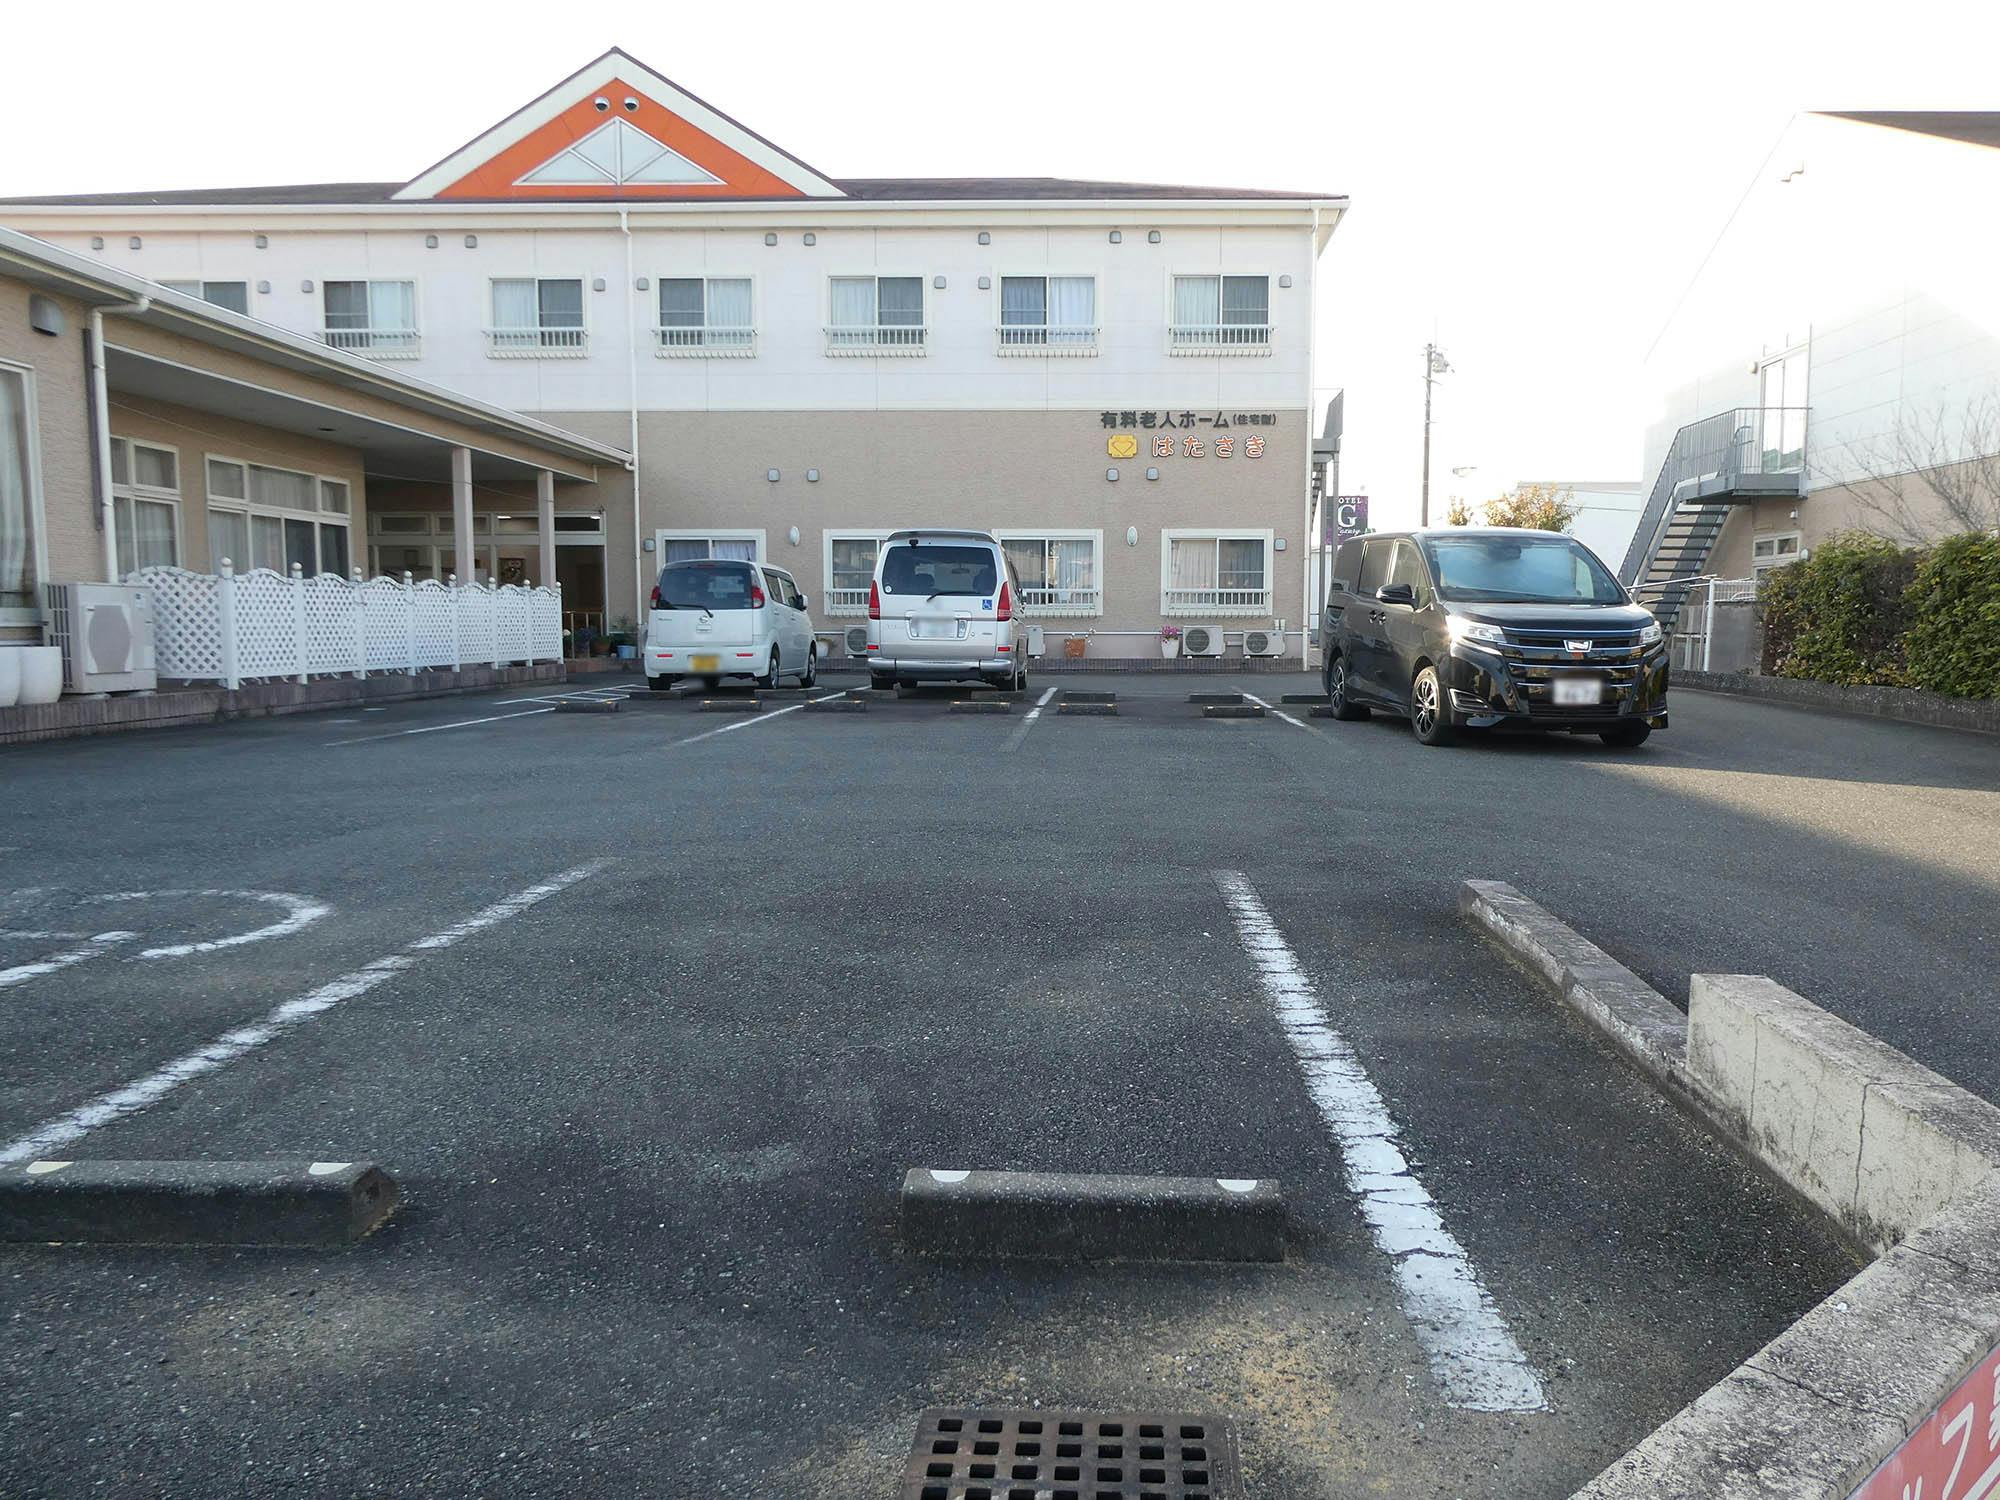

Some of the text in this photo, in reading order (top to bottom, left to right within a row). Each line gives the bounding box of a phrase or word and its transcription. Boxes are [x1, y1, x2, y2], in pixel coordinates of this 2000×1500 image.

[1152, 435, 1265, 458] はたさき
[1338, 504, 1357, 528] G
